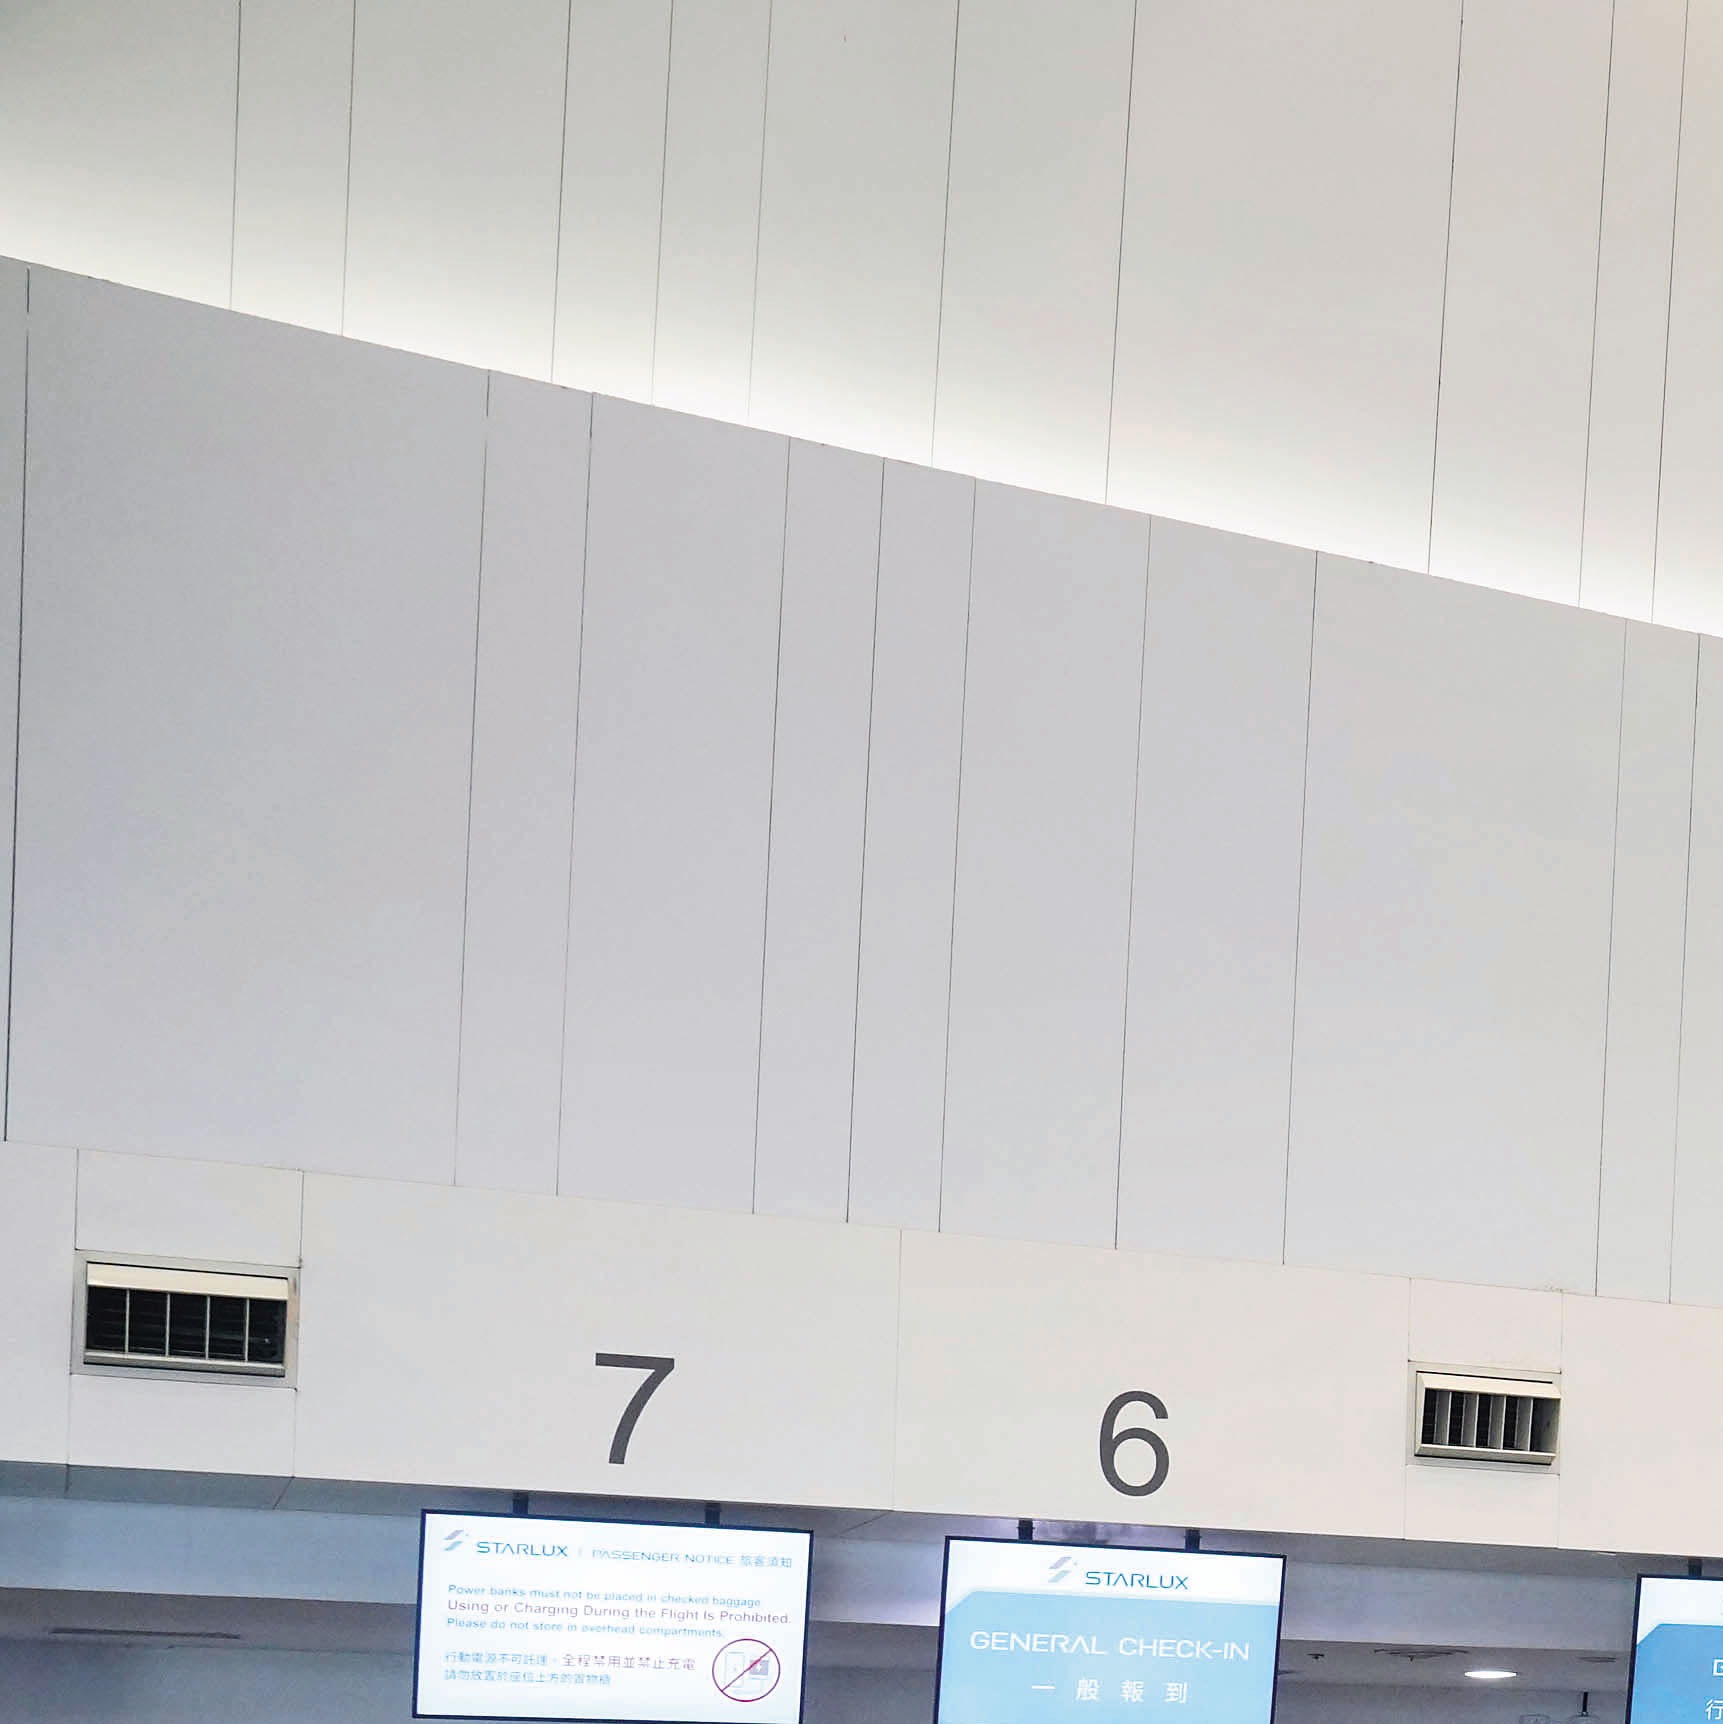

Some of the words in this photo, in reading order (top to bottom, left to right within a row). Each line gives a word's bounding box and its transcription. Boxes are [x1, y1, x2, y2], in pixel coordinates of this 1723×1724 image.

[594, 1352, 675, 1465] 7
[1098, 1390, 1171, 1496] 6
[476, 1541, 568, 1558] STARLUX
[592, 1549, 680, 1563] PASSENGER
[685, 1553, 734, 1566] NOTICE
[448, 1584, 485, 1596] Power
[489, 1586, 526, 1597] banks
[529, 1588, 560, 1599] must
[563, 1589, 582, 1600] not
[1085, 1571, 1188, 1590] STARLUX
[448, 1599, 489, 1614] Using
[494, 1603, 510, 1612] or
[514, 1601, 578, 1618] Charging
[583, 1603, 630, 1620] During
[634, 1606, 657, 1618] the
[661, 1607, 699, 1623] Flight
[703, 1610, 715, 1621] Is
[720, 1610, 792, 1624] Prohibited.
[447, 1617, 486, 1630] Please
[490, 1620, 506, 1630] do
[510, 1621, 528, 1630] not
[533, 1621, 563, 1632] store
[970, 1630, 1107, 1655] GENERAL
[1119, 1637, 1249, 1661] CHECK-IN
[1032, 1678, 1187, 1703] 一般報到
